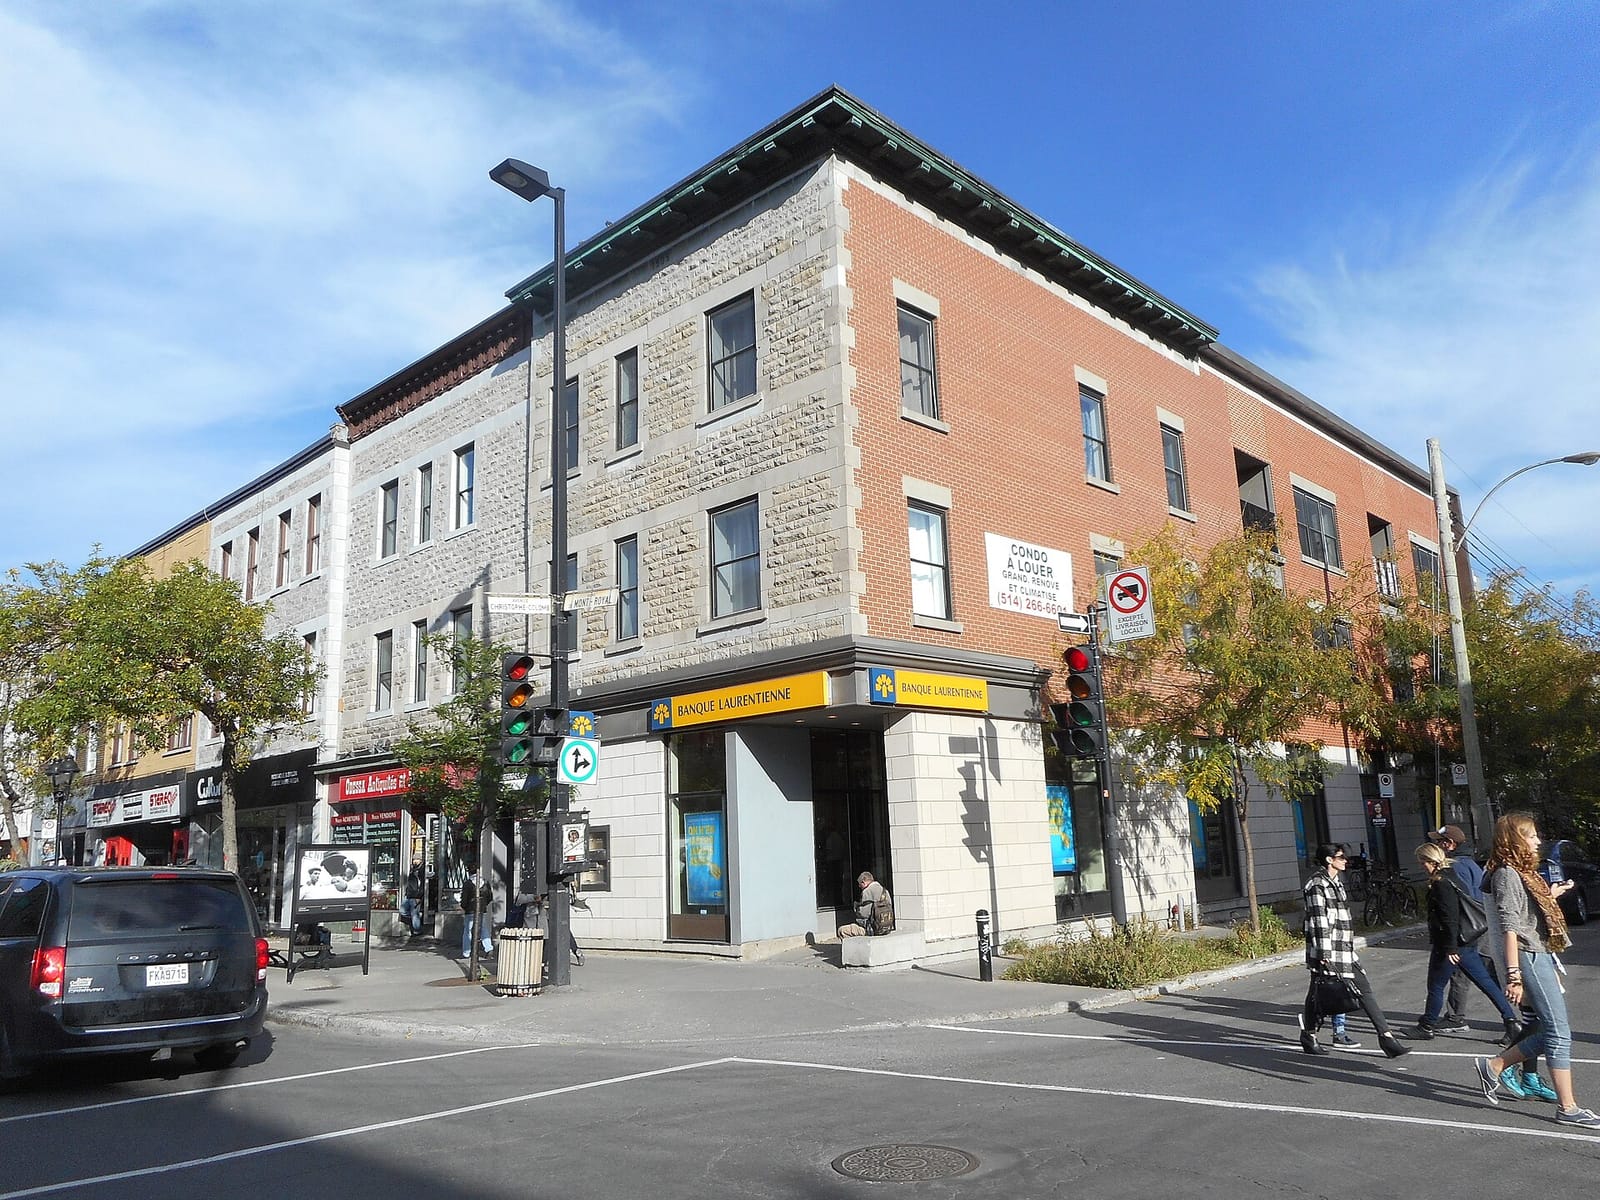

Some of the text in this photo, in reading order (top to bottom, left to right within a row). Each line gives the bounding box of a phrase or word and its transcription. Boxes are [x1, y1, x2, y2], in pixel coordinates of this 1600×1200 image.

[1011, 544, 1048, 563] CONDO
[1018, 559, 1054, 579] LOUER
[1009, 583, 1018, 593] ET
[997, 591, 1023, 610] (514)
[1115, 619, 1149, 630] LIVRAISON
[1121, 626, 1144, 636] LOCALE
[901, 682, 983, 699] BANQUE LAURENTIENNE
[677, 687, 791, 717] BANQUE LAURENTIENNE
[149, 969, 187, 982] FKA9715
